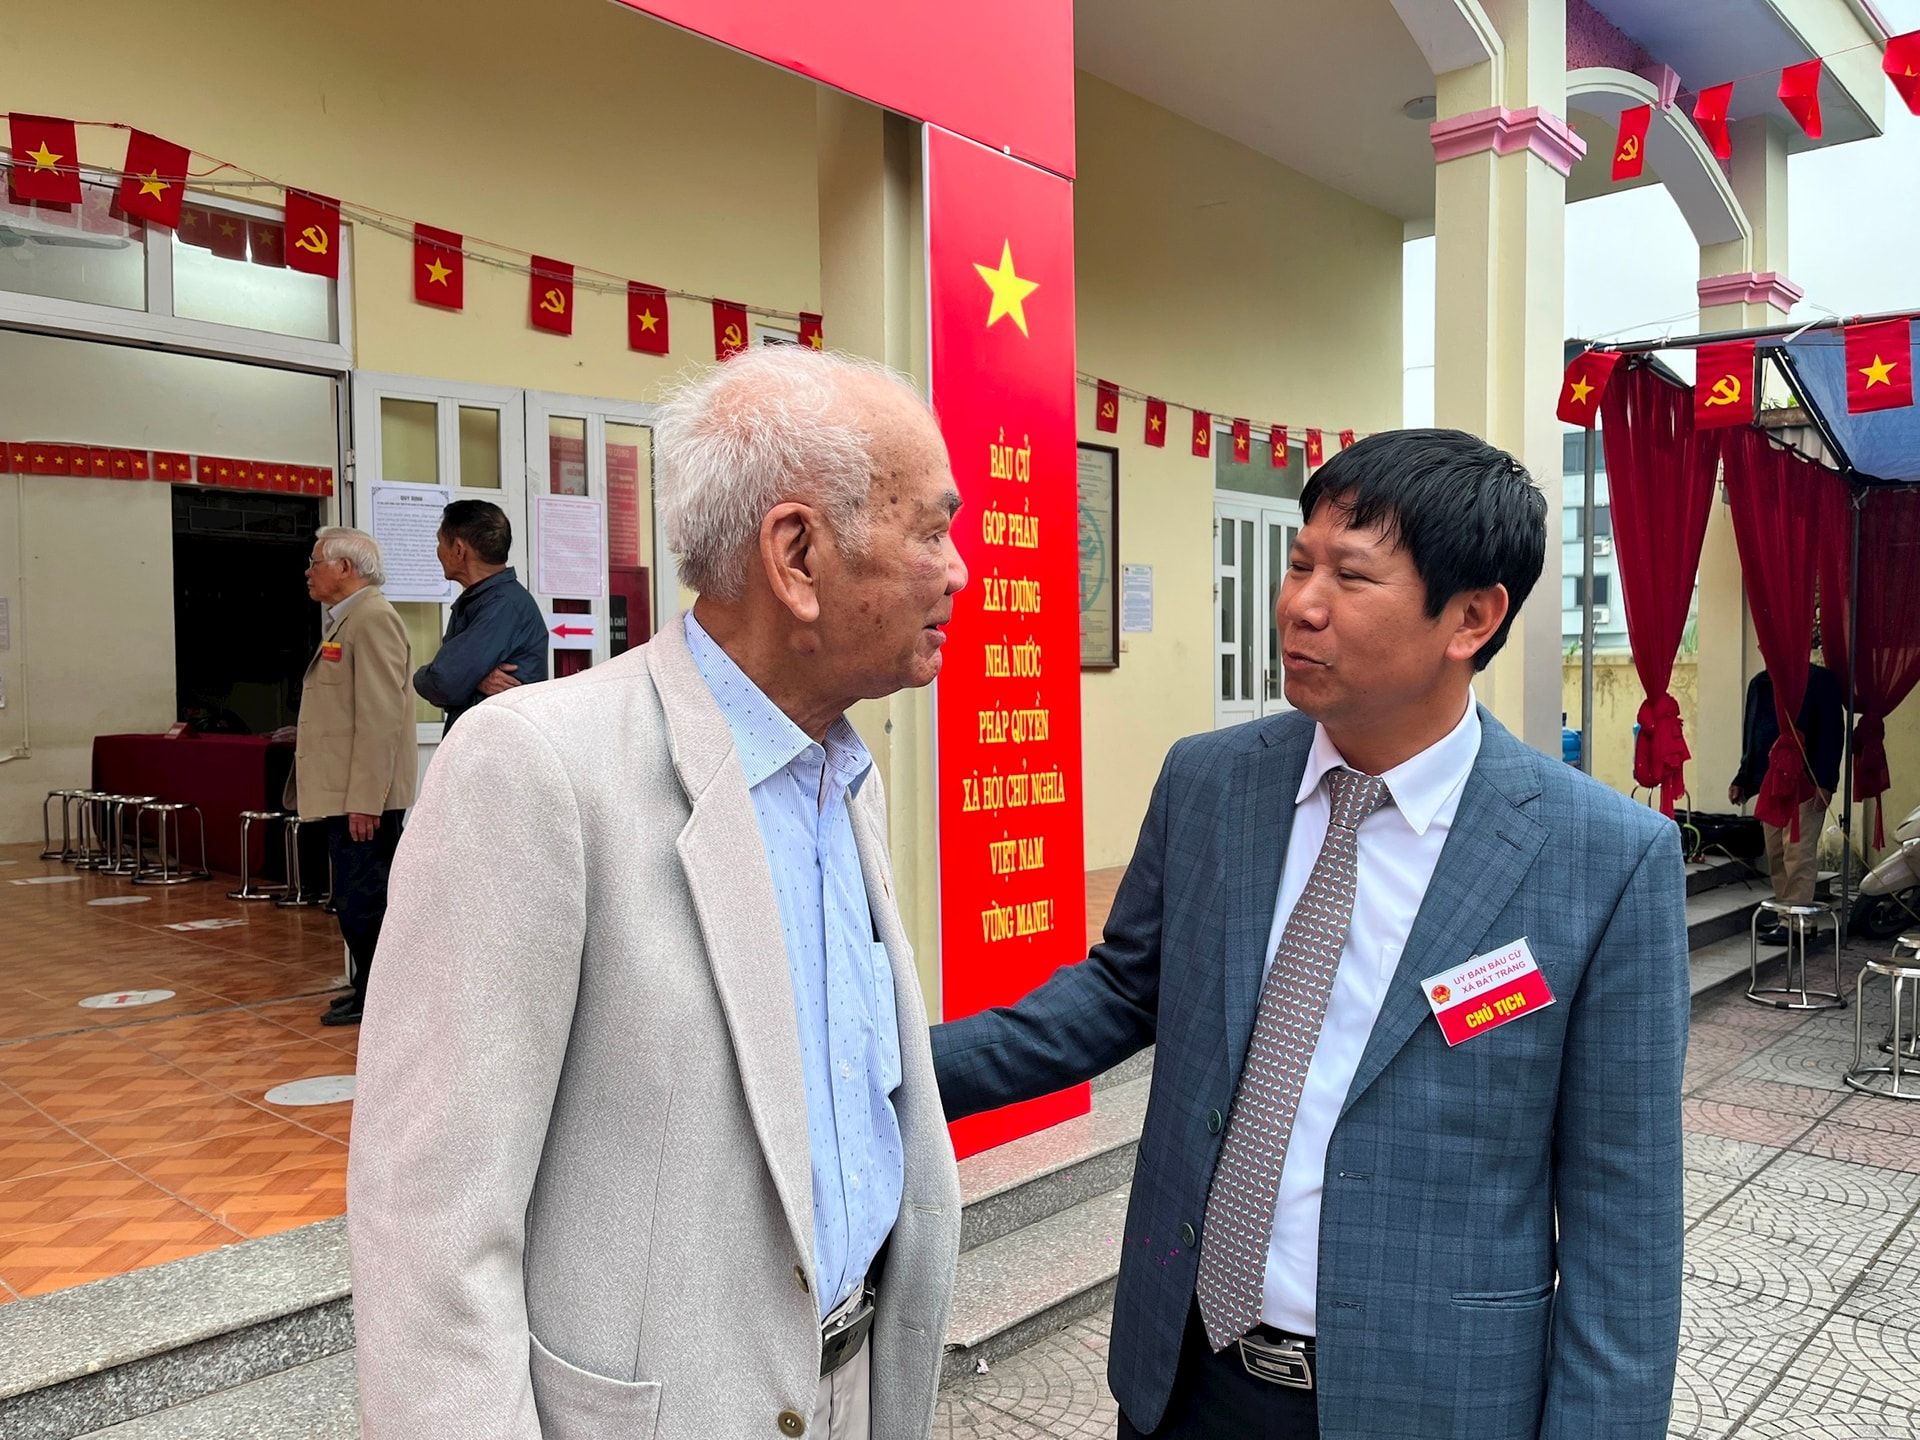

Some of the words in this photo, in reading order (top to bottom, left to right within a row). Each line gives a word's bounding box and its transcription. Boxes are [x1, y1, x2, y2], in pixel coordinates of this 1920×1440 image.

[989, 426, 1014, 481] BẦU
[1015, 434, 1031, 483] CỬ
[982, 500, 1007, 545] GÓP
[1008, 497, 1039, 549] PHẦN
[983, 567, 1009, 612] XÂY
[1010, 575, 1041, 621] DỰNG
[985, 634, 1011, 678] NHÀ
[1012, 634, 1042, 678] NƯỚC
[978, 700, 1010, 744] PHÁP
[1011, 691, 1049, 744] QUYỀN
[962, 769, 981, 812] XÃ
[982, 765, 1005, 818] HỘI
[1005, 758, 1029, 808] CHỦ
[1030, 763, 1066, 805] NGHĨA
[989, 830, 1017, 882] VIỆT
[1018, 836, 1045, 871] NAM
[981, 899, 1015, 943] VỮNG
[1461, 982, 1476, 994] XÃ
[1475, 974, 1494, 988] BÁT
[1494, 960, 1527, 980] TRÀNG
[1467, 965, 1487, 980] BAN
[1487, 956, 1507, 970] BẦU
[1507, 949, 1522, 961] CỬ
[1465, 1002, 1495, 1029] CHỦ
[1493, 991, 1527, 1016] TỊCH
